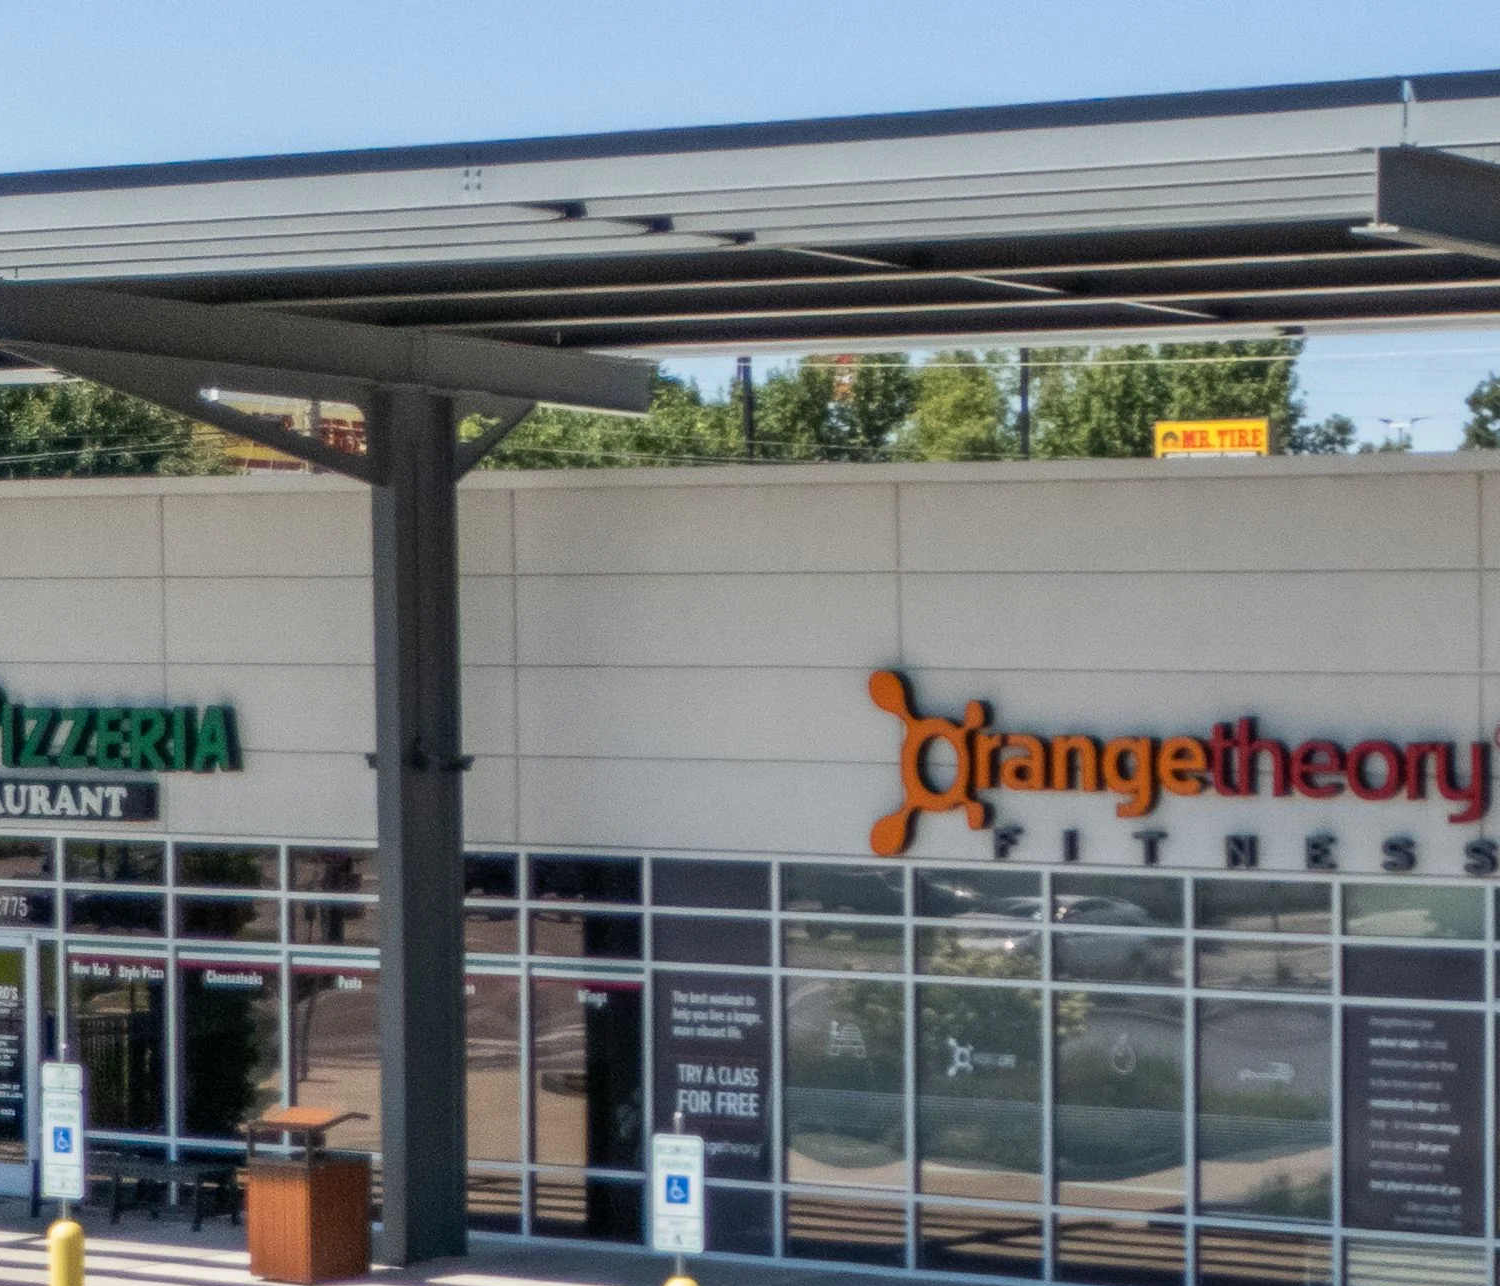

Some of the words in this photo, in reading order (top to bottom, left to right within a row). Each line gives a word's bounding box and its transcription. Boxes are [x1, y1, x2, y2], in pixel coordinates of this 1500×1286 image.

[1218, 429, 1262, 448] TIRE
[995, 826, 1499, 876] FITNESS
[72, 961, 90, 975] New
[92, 963, 111, 977] York
[142, 965, 165, 980] Pizza
[206, 969, 264, 987] Cheesesteaks
[338, 975, 363, 991] Pasta
[678, 1064, 703, 1083] TRY
[705, 1065, 716, 1084] A
[719, 1066, 759, 1087] CLASS
[678, 1088, 712, 1114] FOR
[715, 1090, 760, 1117] FREE
